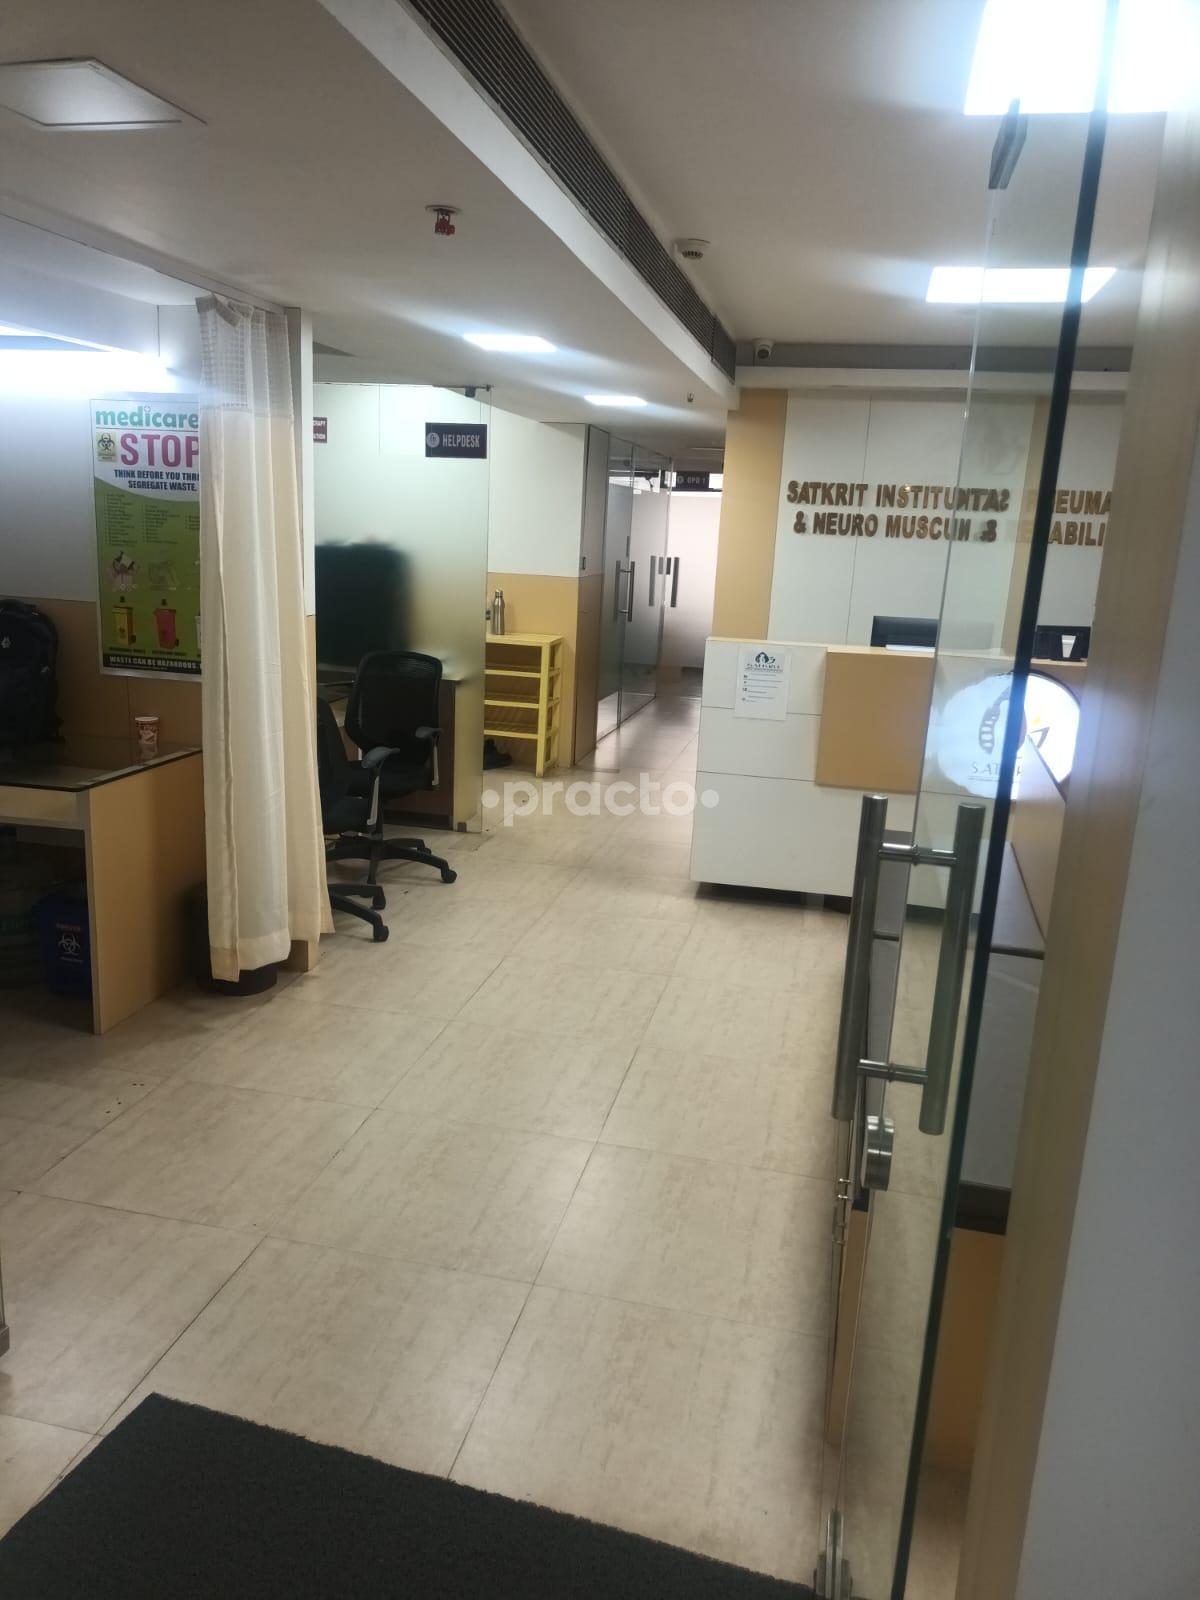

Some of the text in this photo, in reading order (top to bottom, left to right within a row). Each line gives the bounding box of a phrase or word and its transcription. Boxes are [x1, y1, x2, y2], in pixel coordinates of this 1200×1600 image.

[95, 406, 199, 429] medicare
[120, 433, 199, 468] STOP
[442, 434, 480, 448] HELPDESK
[114, 469, 136, 478] THINK
[137, 470, 163, 480] BEFORE
[166, 471, 180, 481] YOU
[128, 480, 168, 490] SEGREGATE
[787, 480, 868, 507] SATKRIT
[793, 511, 807, 535] &
[813, 512, 878, 537] NEURO
